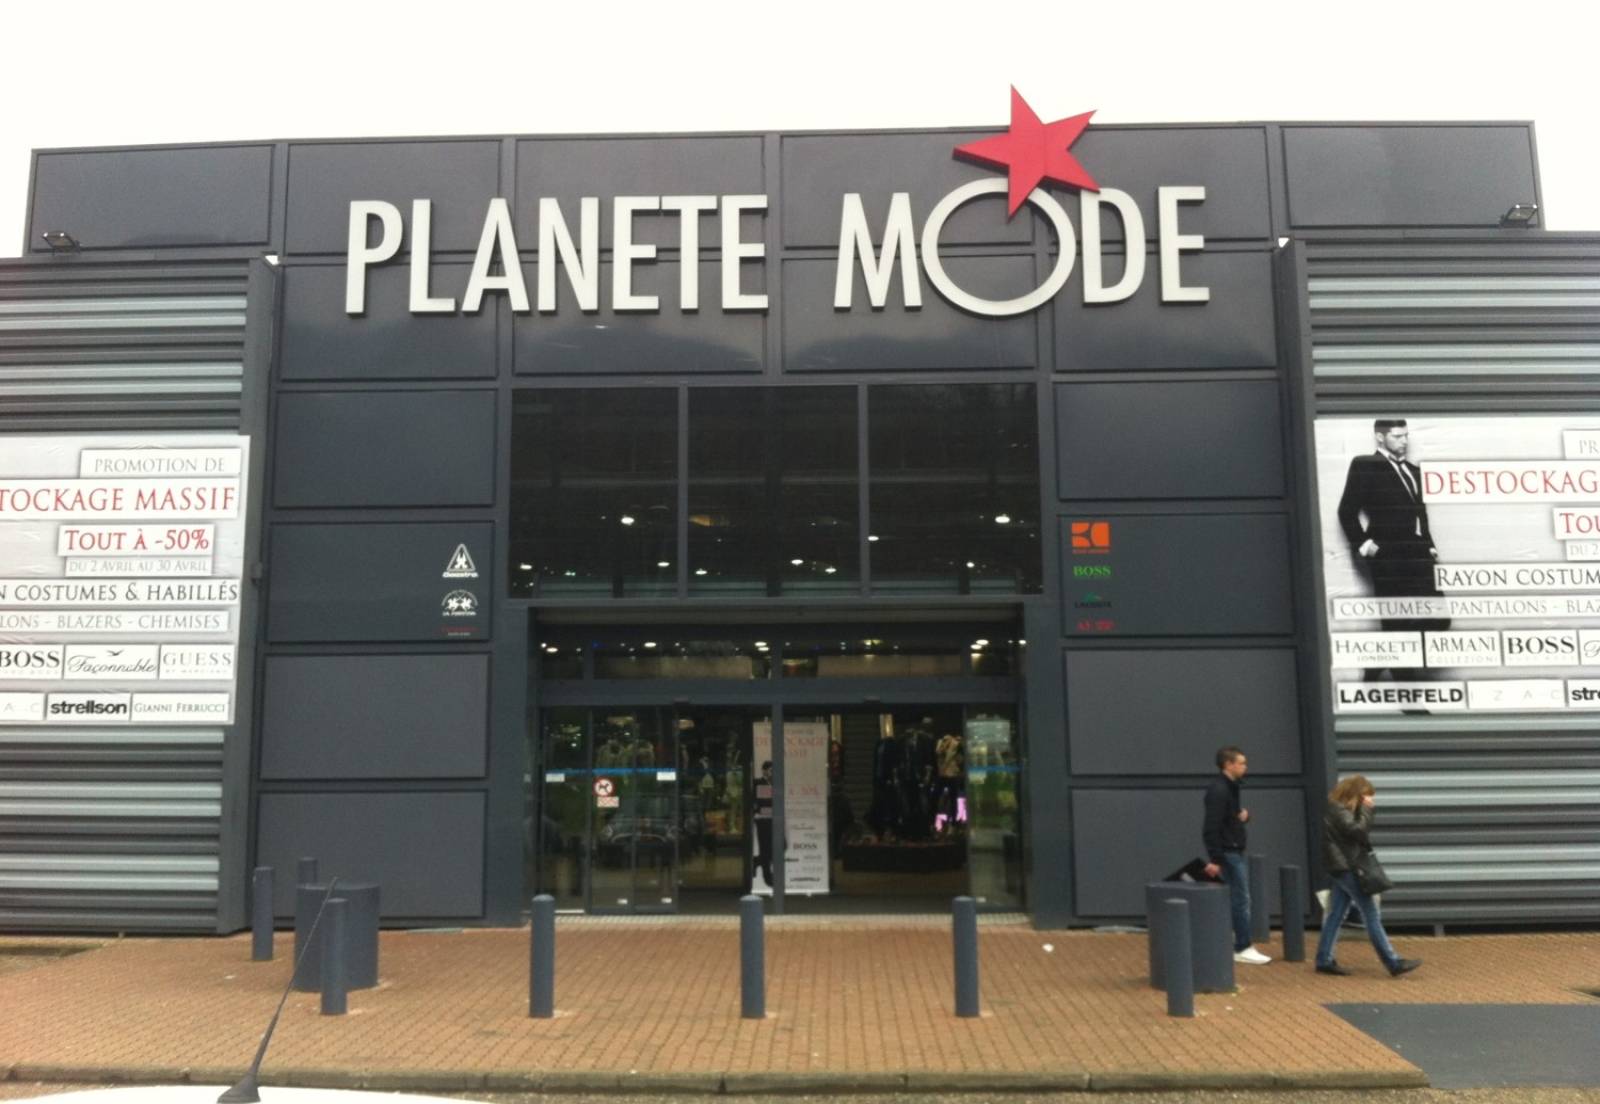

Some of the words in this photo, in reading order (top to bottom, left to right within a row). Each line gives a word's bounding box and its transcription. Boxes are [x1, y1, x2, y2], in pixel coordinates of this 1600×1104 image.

[346, 194, 768, 315] PLANETE
[834, 176, 1210, 317] MODE
[95, 457, 198, 473] PROMOTION
[205, 457, 225, 472] DE
[1424, 470, 1598, 495] DESTOCKAG
[0, 488, 124, 511] TOCKAGE
[135, 487, 235, 511] MASSIF
[134, 528, 148, 550] À
[155, 528, 209, 550] -50%
[69, 561, 86, 572] DU
[91, 560, 97, 571] 2
[102, 560, 133, 571] AVRIL
[139, 560, 153, 571] AU
[157, 559, 171, 571] 30
[174, 559, 208, 571] AVRIL
[1073, 566, 1111, 576] BOSS
[1515, 568, 1600, 586] COSTUM
[15, 584, 117, 601] COSTUMES
[125, 582, 139, 600] &
[147, 581, 238, 600] HABILLÉS
[1340, 601, 1432, 616] COSTUMES
[1450, 600, 1547, 615] PANTALONS
[57, 614, 122, 628] BLAZERS
[138, 613, 220, 628] CHEMISES
[1336, 640, 1418, 653] HACKETT
[1431, 637, 1495, 652] ARMANI
[1508, 636, 1575, 654] BOSS
[0, 650, 60, 668] BOSS
[67, 654, 157, 674] Façonnable
[163, 652, 231, 665] GUESS
[1340, 688, 1463, 703] LAGERFELD
[50, 699, 127, 714] strellson
